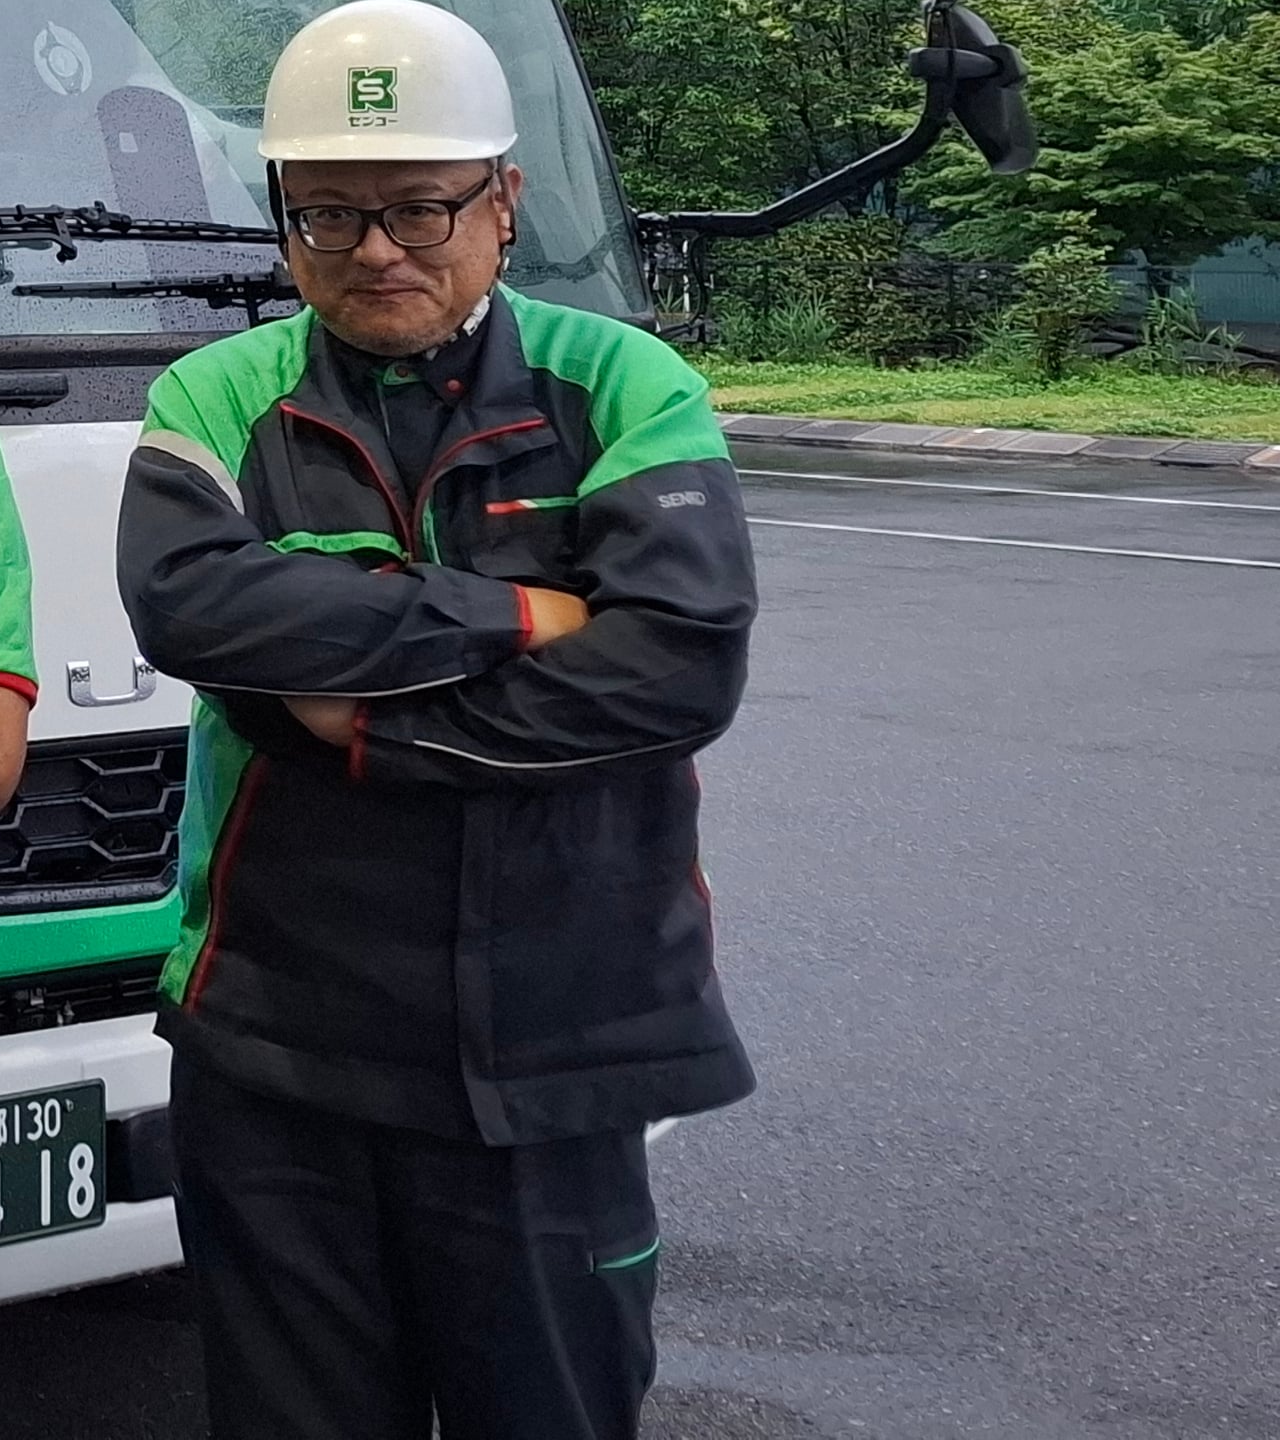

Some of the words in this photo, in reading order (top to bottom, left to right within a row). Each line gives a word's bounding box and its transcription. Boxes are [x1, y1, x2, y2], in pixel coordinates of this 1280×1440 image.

[348, 116, 399, 127] センコー
[656, 490, 707, 509] SENO
